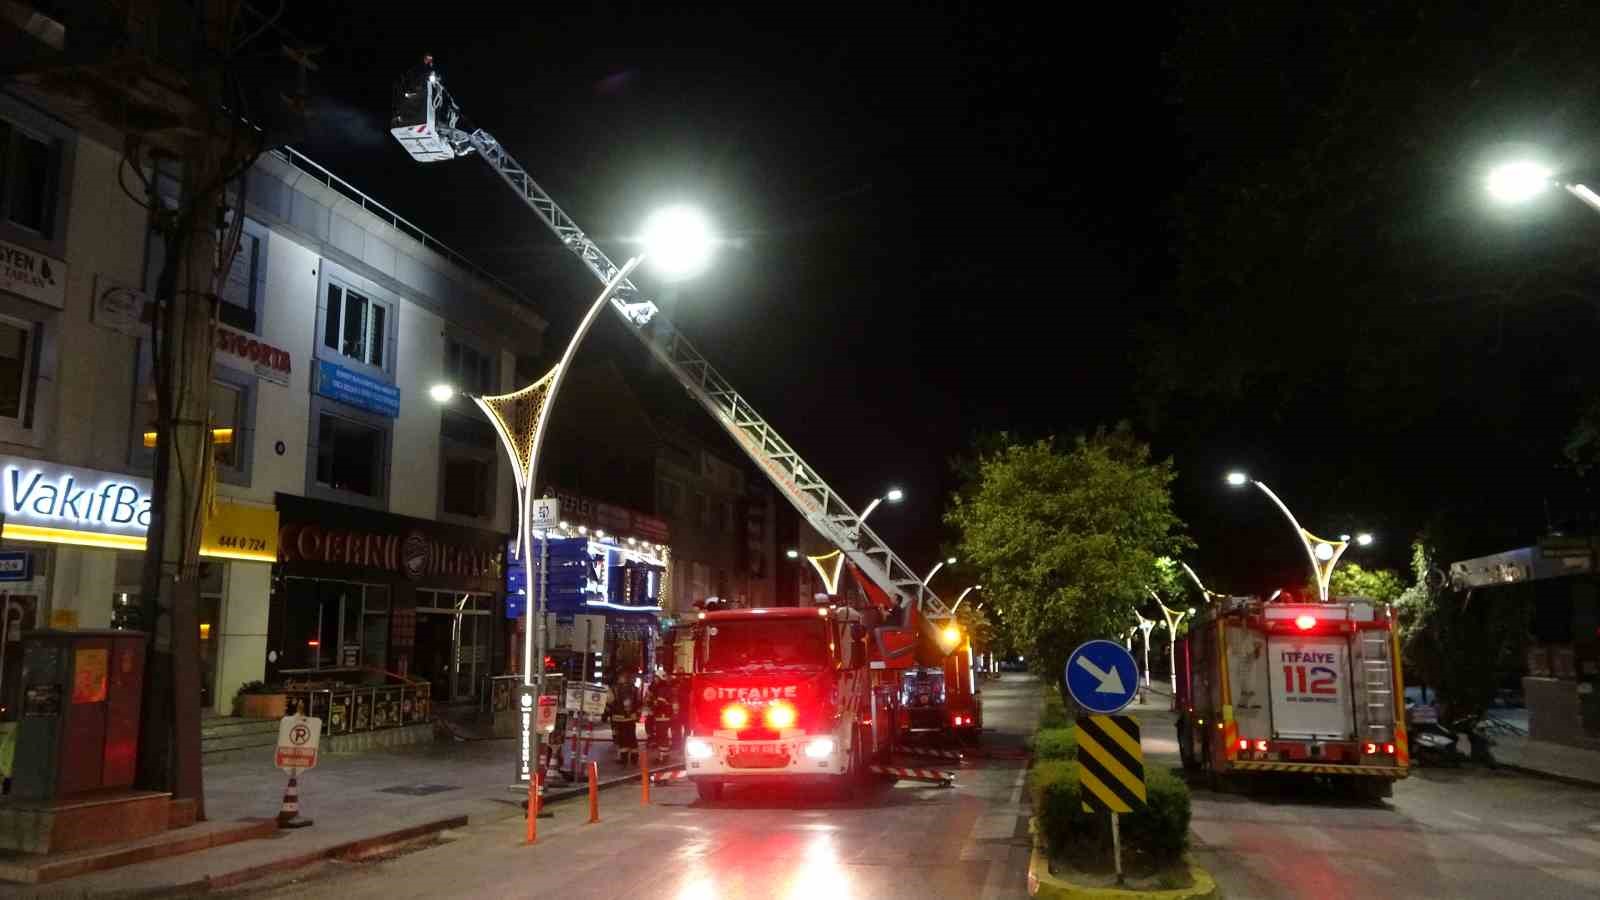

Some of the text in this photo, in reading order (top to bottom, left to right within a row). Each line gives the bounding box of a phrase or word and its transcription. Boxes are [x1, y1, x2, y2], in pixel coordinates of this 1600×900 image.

[218, 535, 266, 551] 444 0 724
[1283, 665, 1337, 694] 112
